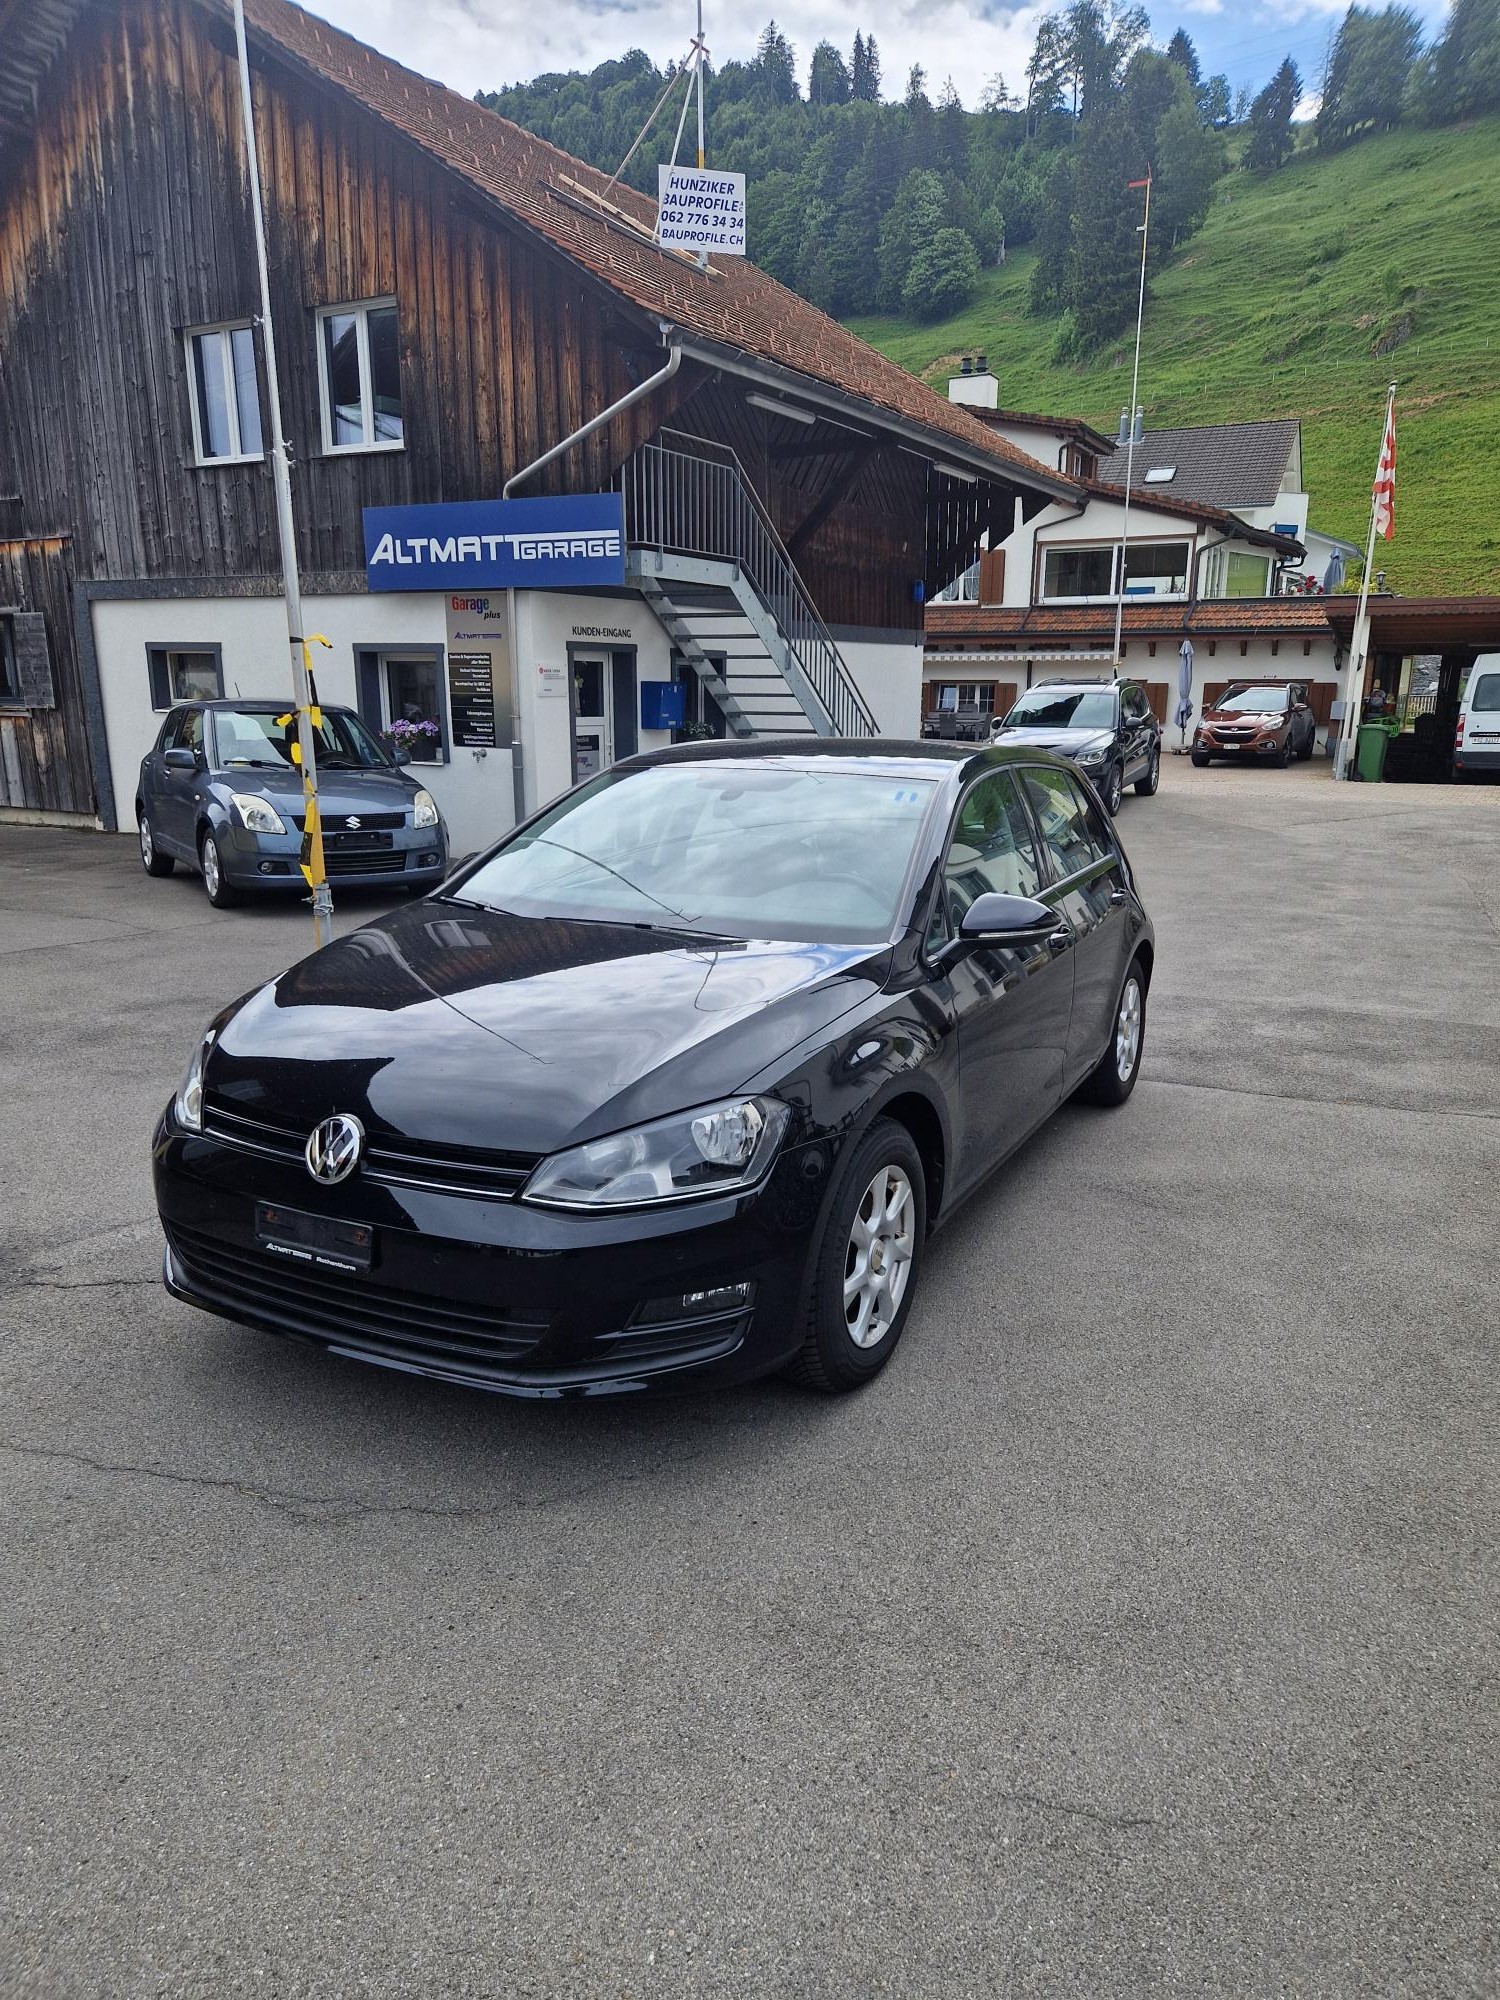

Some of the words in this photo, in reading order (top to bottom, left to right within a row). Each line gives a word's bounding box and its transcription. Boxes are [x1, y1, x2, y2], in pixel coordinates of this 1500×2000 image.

[670, 177, 735, 195] HUNZIKER
[663, 193, 739, 212] BAUPROFILE
[661, 210, 684, 224] 062
[687, 212, 709, 226] 776
[712, 215, 726, 227] 34
[729, 217, 744, 229] 34
[662, 228, 744, 245] BAUPROFILE.CH
[452, 595, 490, 614] Garage
[484, 610, 501, 620] plus
[572, 625, 632, 638] KUNDEN-EINGANG
